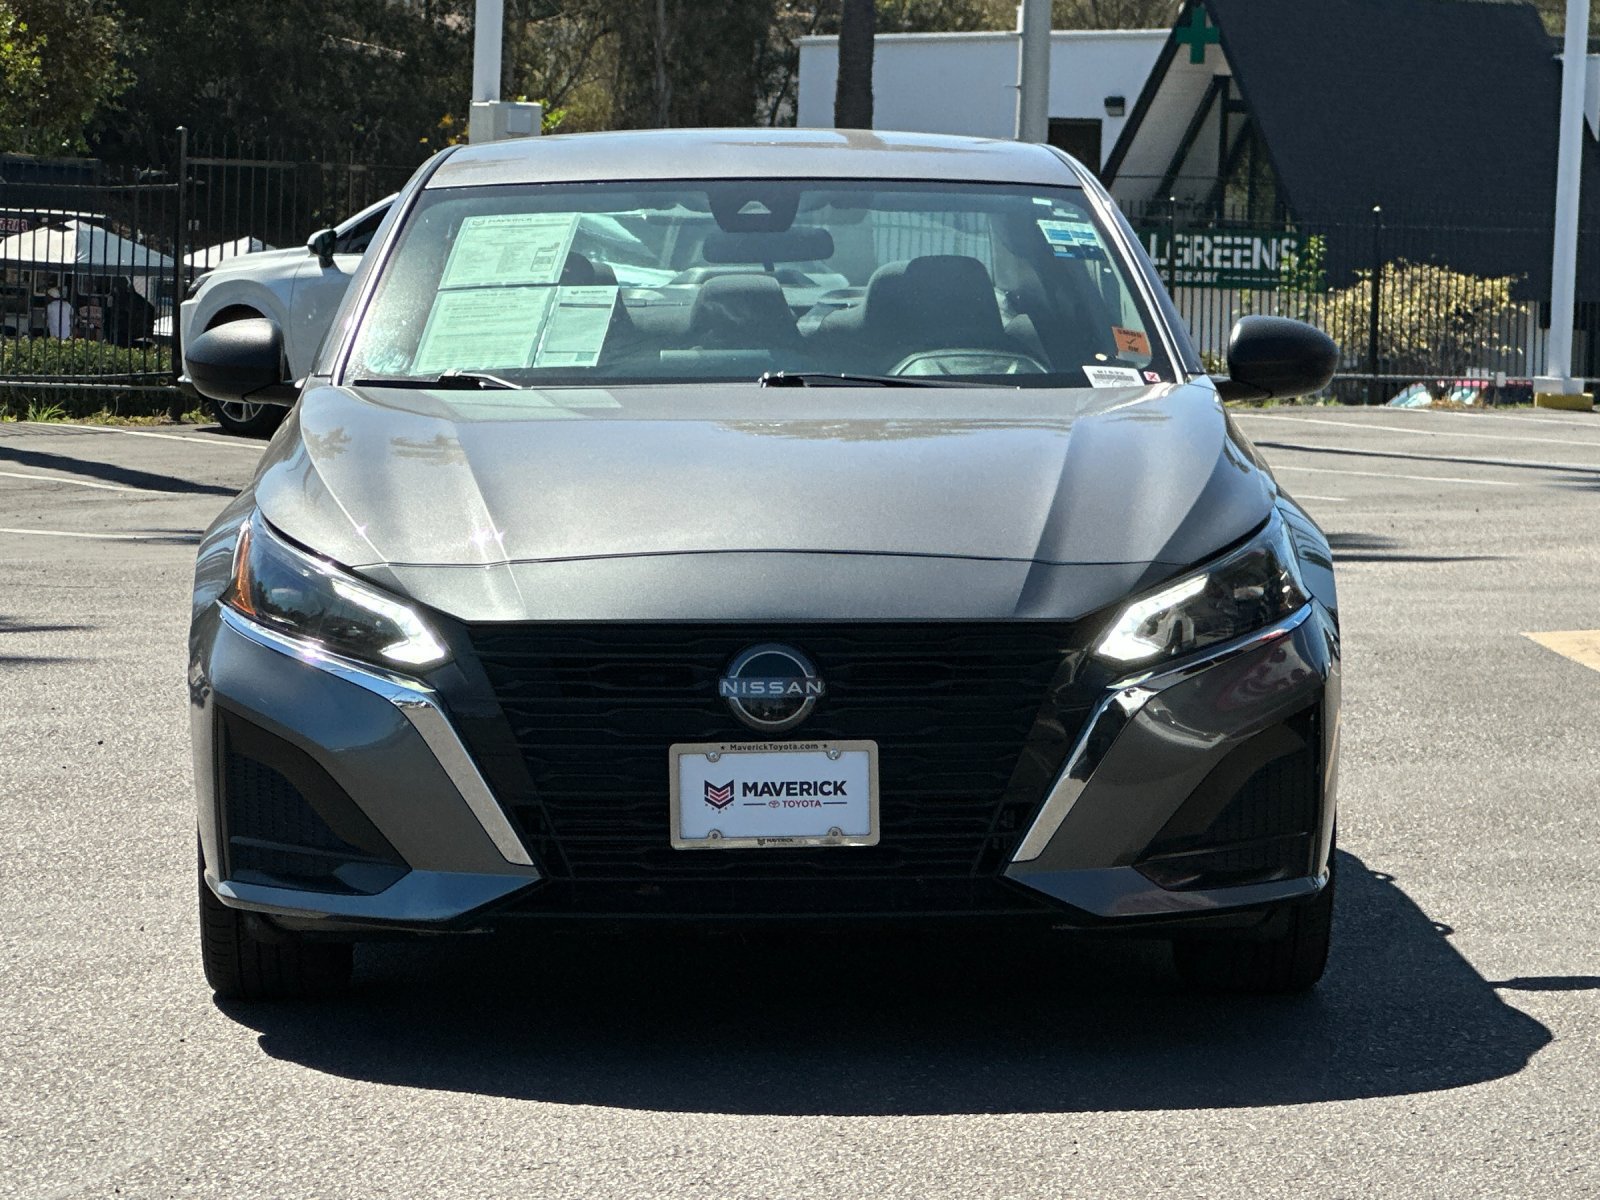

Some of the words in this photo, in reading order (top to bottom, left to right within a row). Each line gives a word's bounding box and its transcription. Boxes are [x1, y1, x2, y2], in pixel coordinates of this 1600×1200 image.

[722, 681, 821, 694] NISSAN
[730, 742, 818, 751] MaverickToyota.com
[742, 780, 847, 797] MAVERICK
[782, 799, 822, 808] TOYOTA
